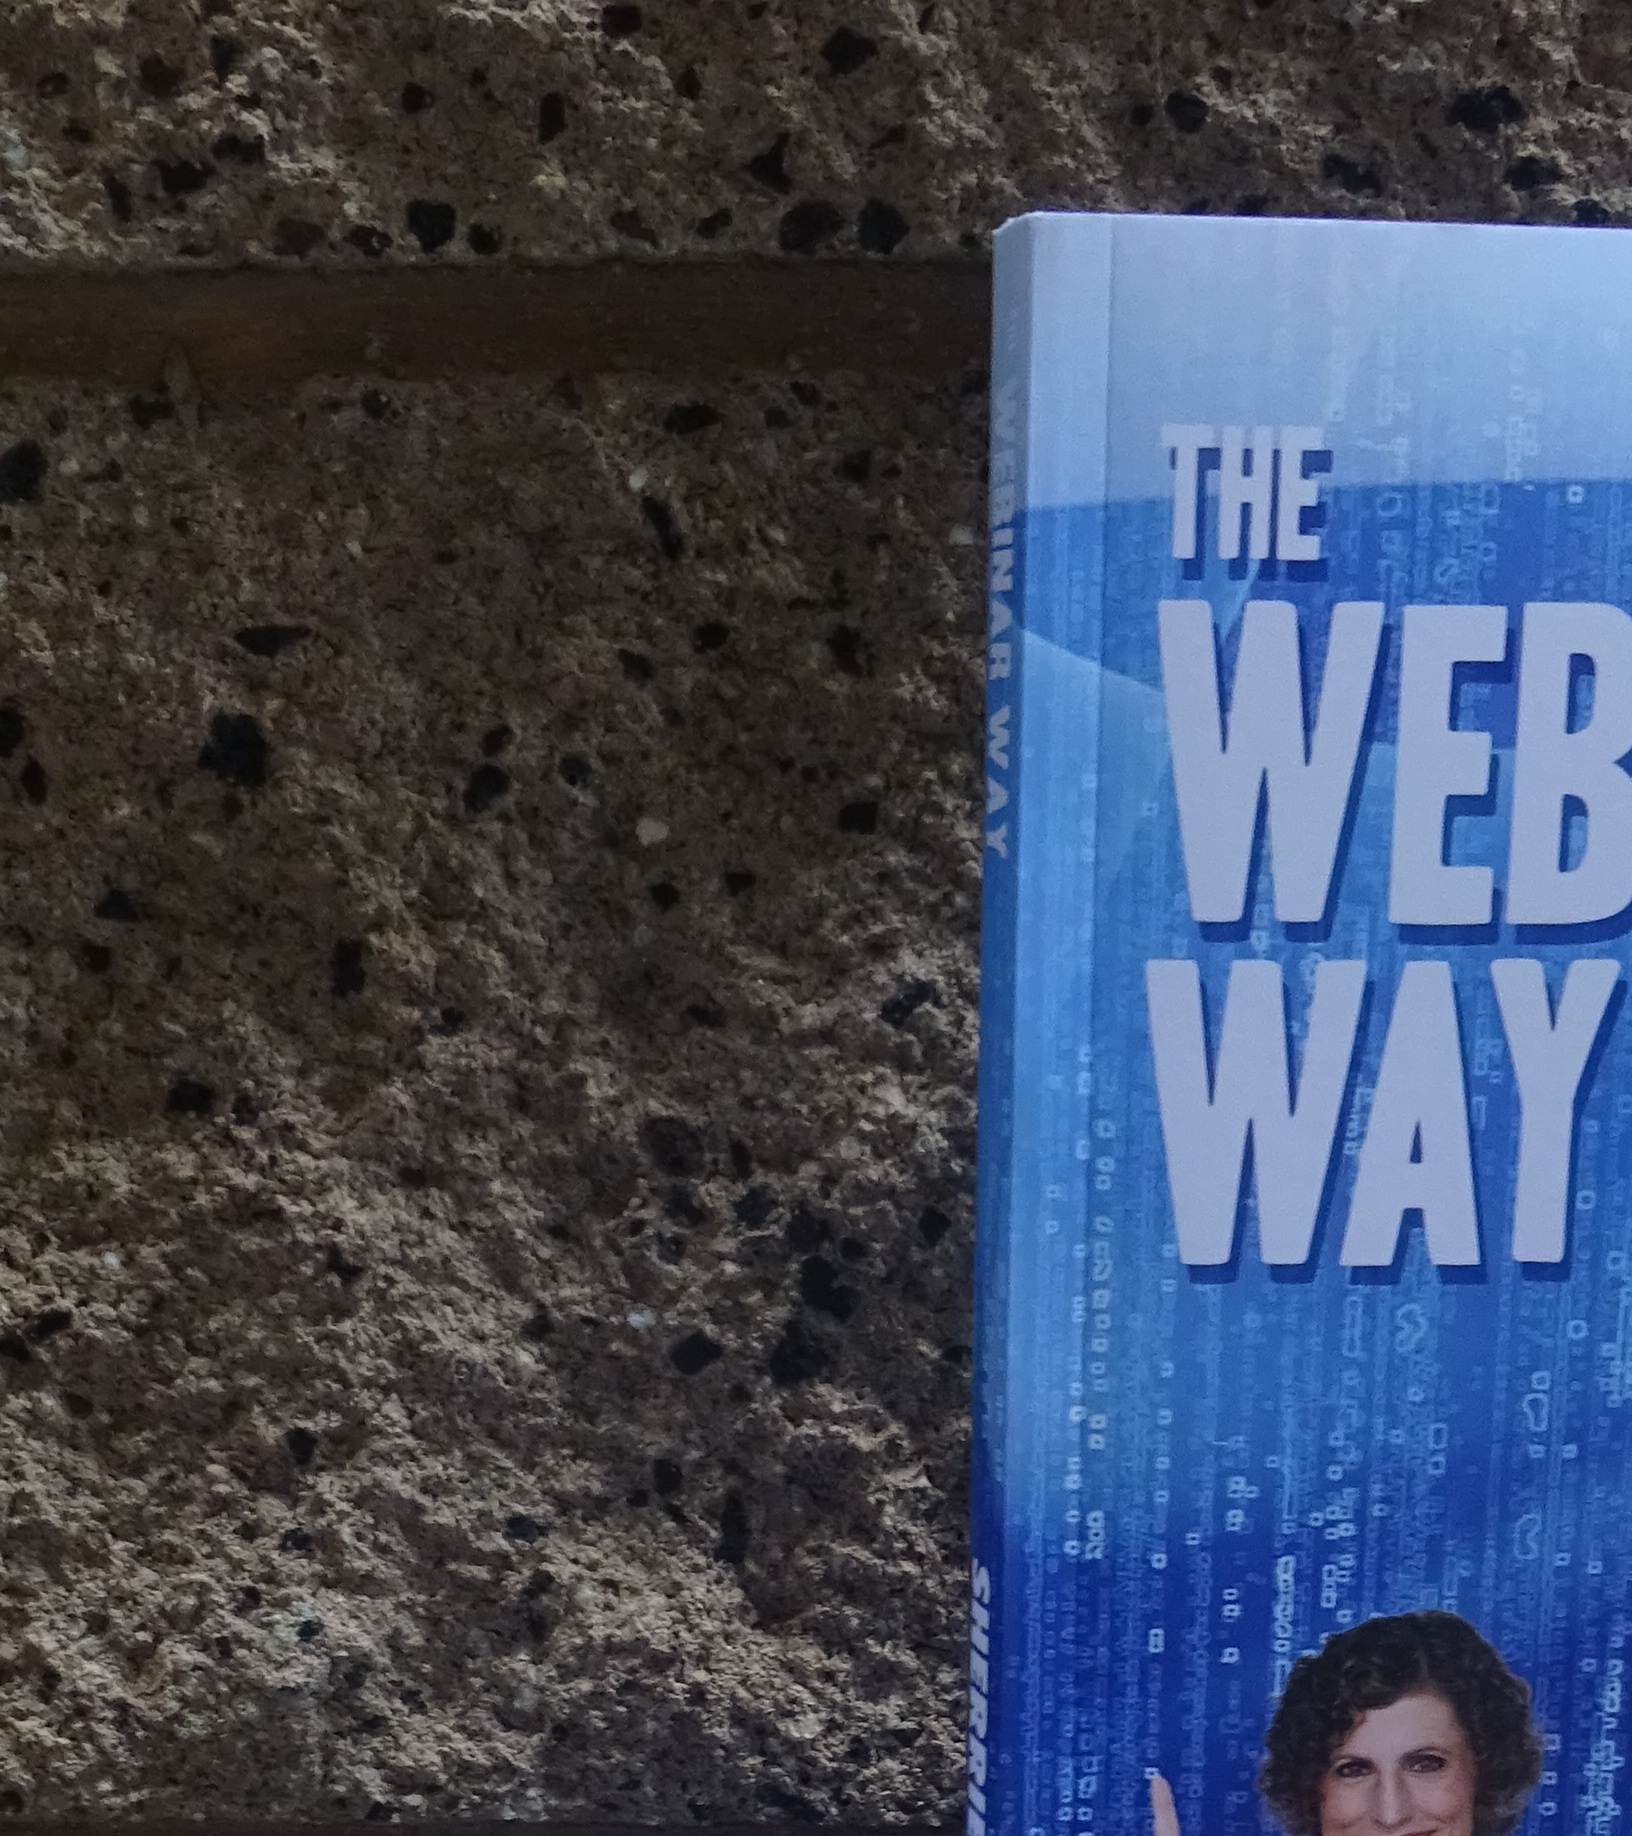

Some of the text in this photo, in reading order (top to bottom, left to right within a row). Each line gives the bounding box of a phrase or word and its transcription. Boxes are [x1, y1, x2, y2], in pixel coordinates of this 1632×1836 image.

[988, 379, 1017, 681] WEBINAR
[1162, 422, 1325, 562] THE
[985, 706, 1010, 859] WAY
[1146, 959, 1620, 1268] WAY
